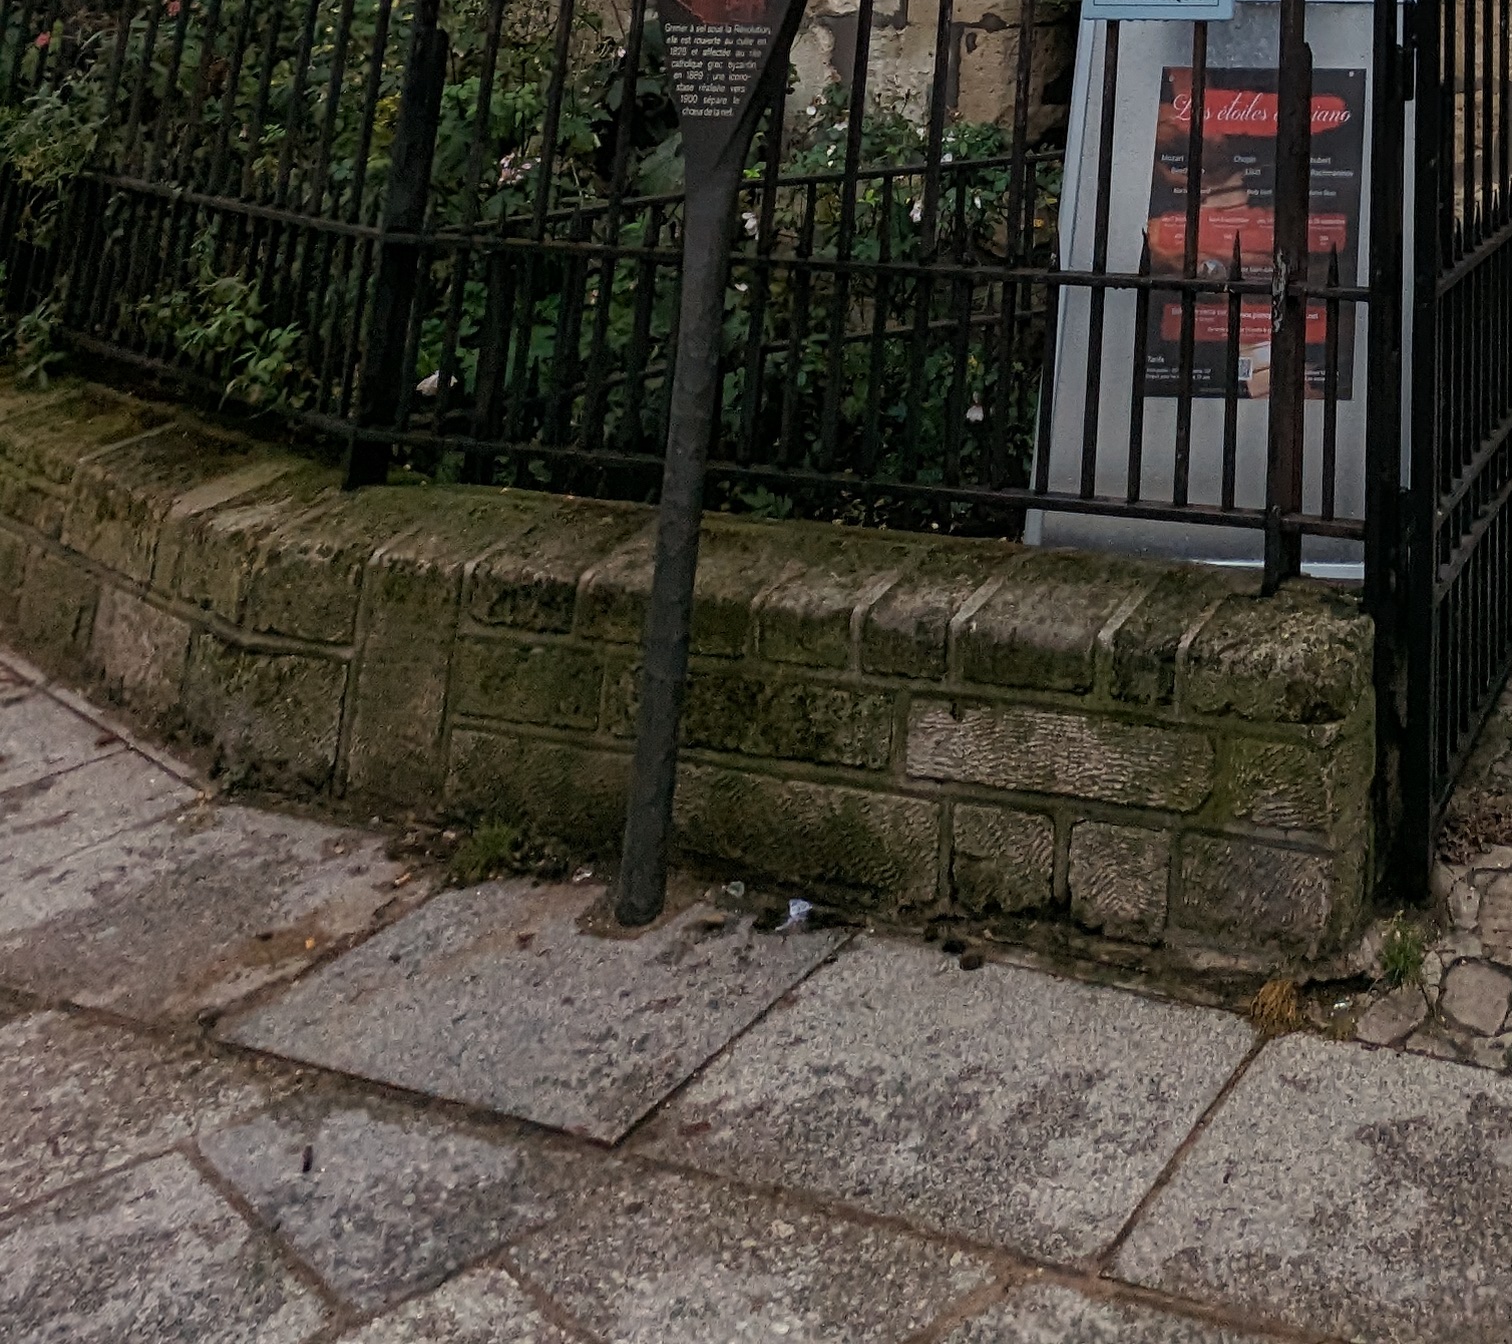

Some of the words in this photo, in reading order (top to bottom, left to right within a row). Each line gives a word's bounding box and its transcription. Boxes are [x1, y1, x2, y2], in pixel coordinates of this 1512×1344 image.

[726, 24, 732, 33] la
[681, 36, 691, 45] est
[674, 72, 683, 80] en
[704, 107, 712, 116] de
[1173, 92, 1210, 121] Ls
[1217, 92, 1267, 121] étoiles
[1311, 105, 1352, 123] iano
[1233, 155, 1257, 164] Chopin
